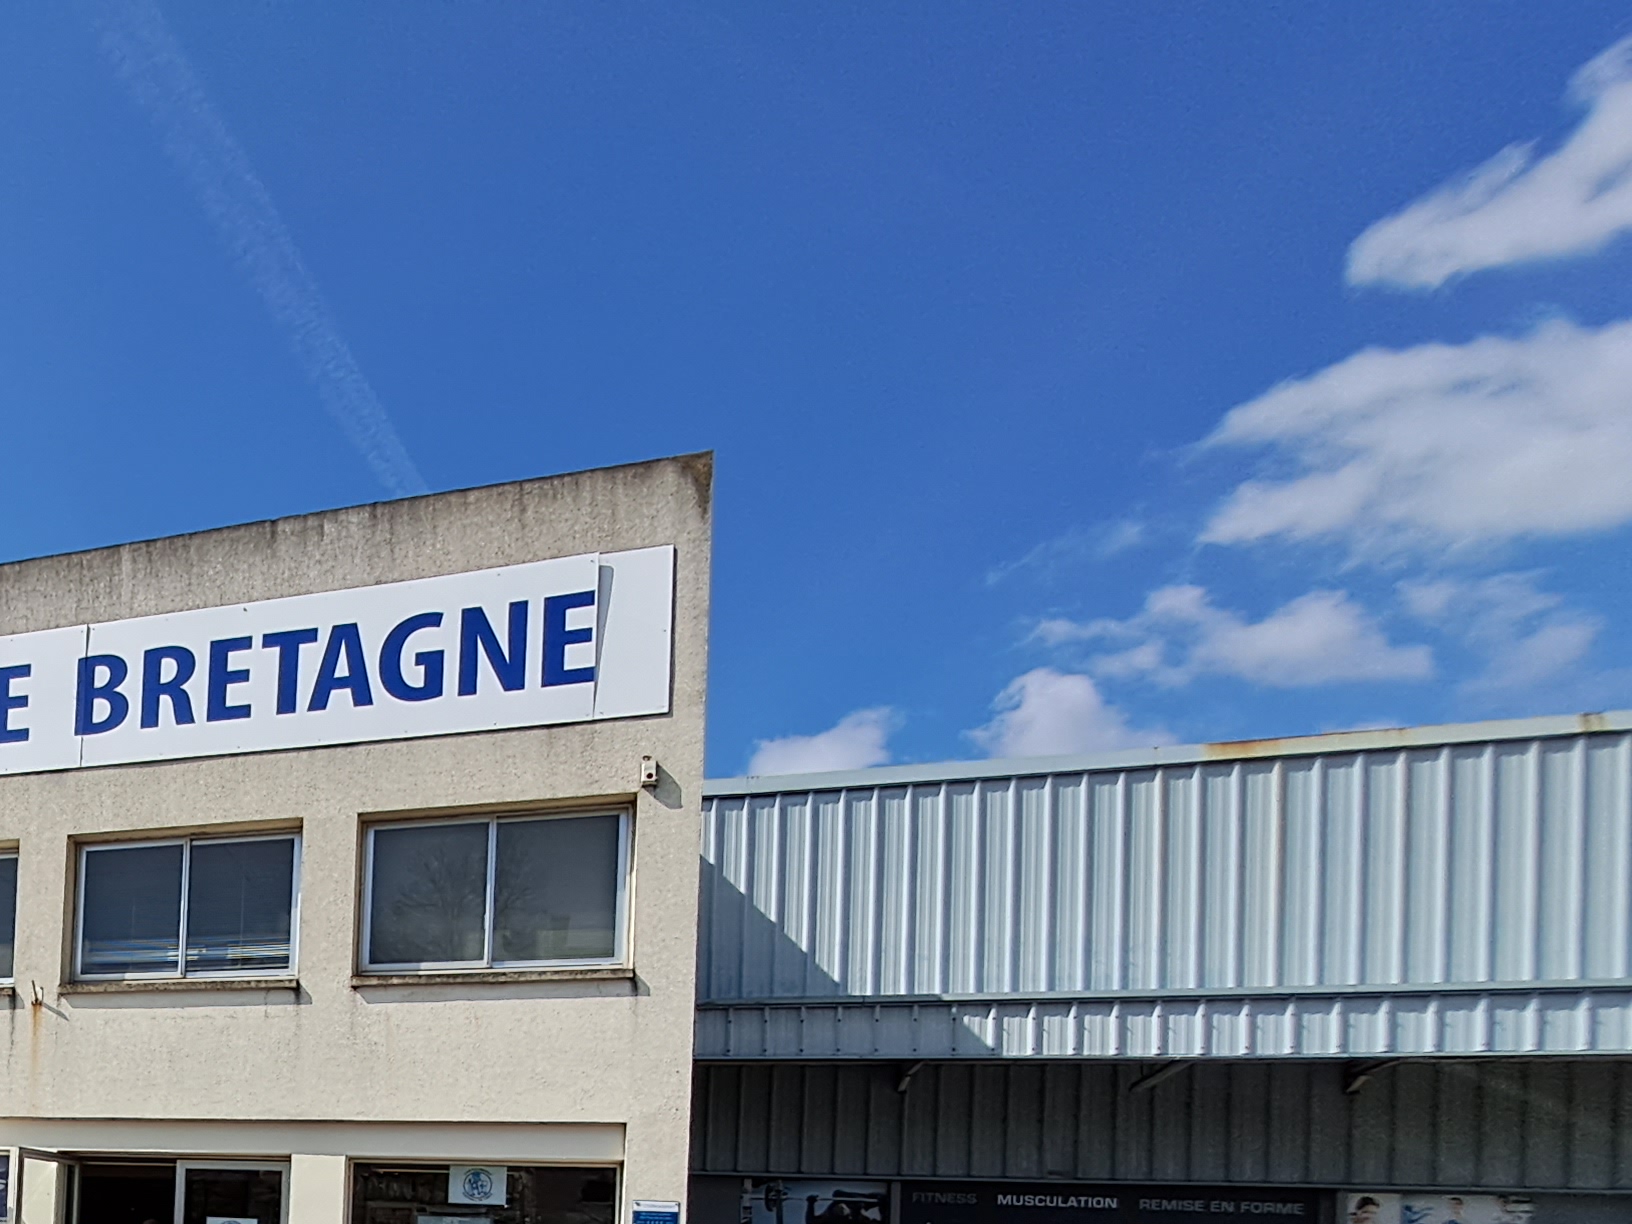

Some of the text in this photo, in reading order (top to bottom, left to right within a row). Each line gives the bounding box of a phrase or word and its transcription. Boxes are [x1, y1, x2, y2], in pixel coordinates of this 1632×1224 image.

[74, 591, 598, 736] BRETAGNE
[911, 1191, 1305, 1216] FITNESS MUSCULATION REMISE EN FORME
